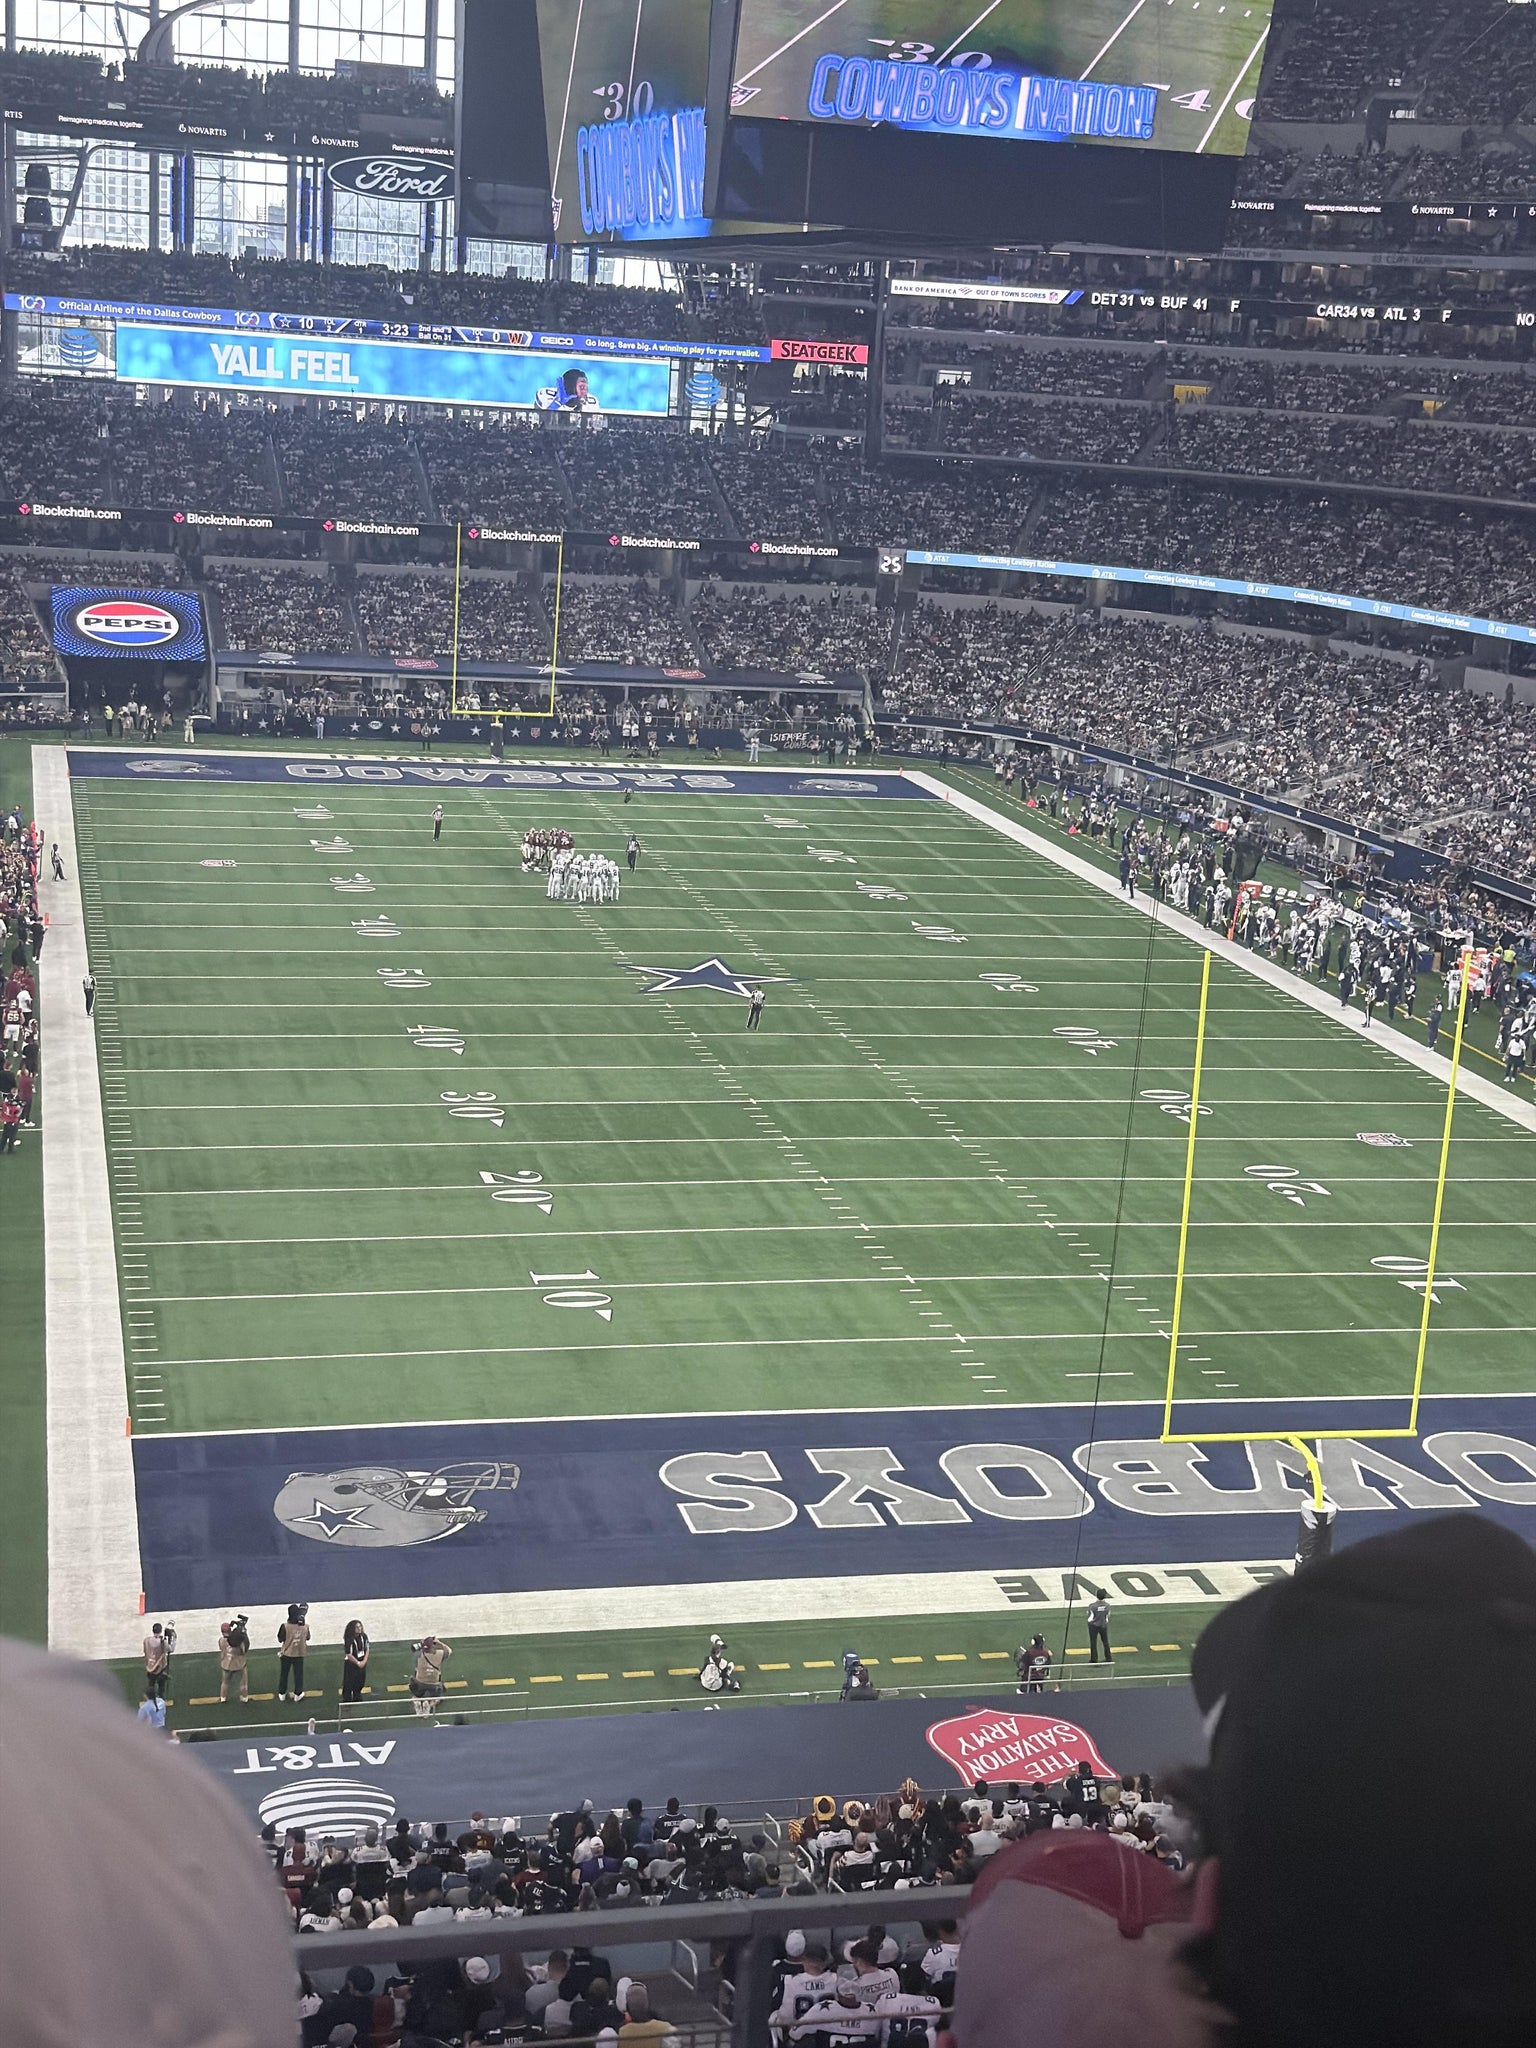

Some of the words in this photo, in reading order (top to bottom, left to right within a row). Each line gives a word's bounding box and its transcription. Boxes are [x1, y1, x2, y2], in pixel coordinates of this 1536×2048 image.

[808, 54, 1015, 128] COWBOYS
[1026, 76, 1158, 140] NATION!
[187, 125, 227, 136] NOVARTIS
[320, 137, 359, 148] NOVARTIS
[355, 160, 448, 196] Ford
[577, 113, 675, 235] COWBOYS
[1237, 201, 1275, 210] NOVARTIS
[1419, 206, 1454, 215] NOVARTIS
[1021, 291, 1047, 299] SCORES
[1091, 292, 1119, 305] DET
[1119, 293, 1135, 306] 31
[1161, 297, 1187, 309] BUF
[1192, 297, 1208, 310] 41
[1231, 300, 1240, 312] F
[59, 300, 92, 312] Official
[93, 303, 123, 314] Airline
[124, 305, 135, 315] of
[136, 306, 152, 316] the
[153, 307, 181, 319] Dallas
[182, 310, 222, 323] Cowboys
[1383, 308, 1407, 321] ATL
[1413, 309, 1421, 321] 3
[1442, 309, 1451, 322] F
[298, 316, 314, 330] 10
[381, 323, 409, 337] 3:23
[540, 336, 574, 346] GEICO
[585, 338, 597, 347] Go
[597, 339, 617, 350] long.
[617, 340, 637, 349] Save
[637, 342, 651, 353] big.
[652, 343, 659, 351] A
[659, 344, 689, 355] winning
[689, 346, 705, 356] play
[706, 346, 716, 355] for
[717, 348, 735, 358] your
[735, 349, 760, 358] wallet.
[781, 342, 857, 362] SEATGEEK
[209, 343, 284, 379] YALL
[290, 349, 360, 385] FEEL
[32, 504, 122, 520] Blockchain.com
[186, 513, 273, 529] Blockchain.com
[336, 521, 419, 536] Blockchain.com
[480, 529, 562, 543] Blockchain.com
[621, 535, 700, 550] Blockchain.com
[761, 543, 839, 557] Blockchain.com
[933, 555, 951, 563] AT&T
[83, 617, 172, 630] PEPSI
[285, 764, 736, 789] COWBOYS
[376, 967, 432, 989] 50
[977, 972, 1040, 994] 50
[406, 1023, 466, 1048] 40
[1051, 1026, 1119, 1050] 40
[440, 1090, 506, 1119] 30
[1139, 1089, 1215, 1117] 30
[478, 1169, 554, 1203] 20
[1243, 1164, 1332, 1197] 20
[1370, 1255, 1468, 1293] 10
[528, 1269, 613, 1308] 10
[992, 1567, 1222, 1603] LOVE
[956, 1716, 1021, 1756] ARMY
[233, 1740, 397, 1774] AT&T
[963, 1723, 1080, 1780] SALVATION
[1023, 1750, 1080, 1780] THE
[1081, 1786, 1098, 1802] 13
